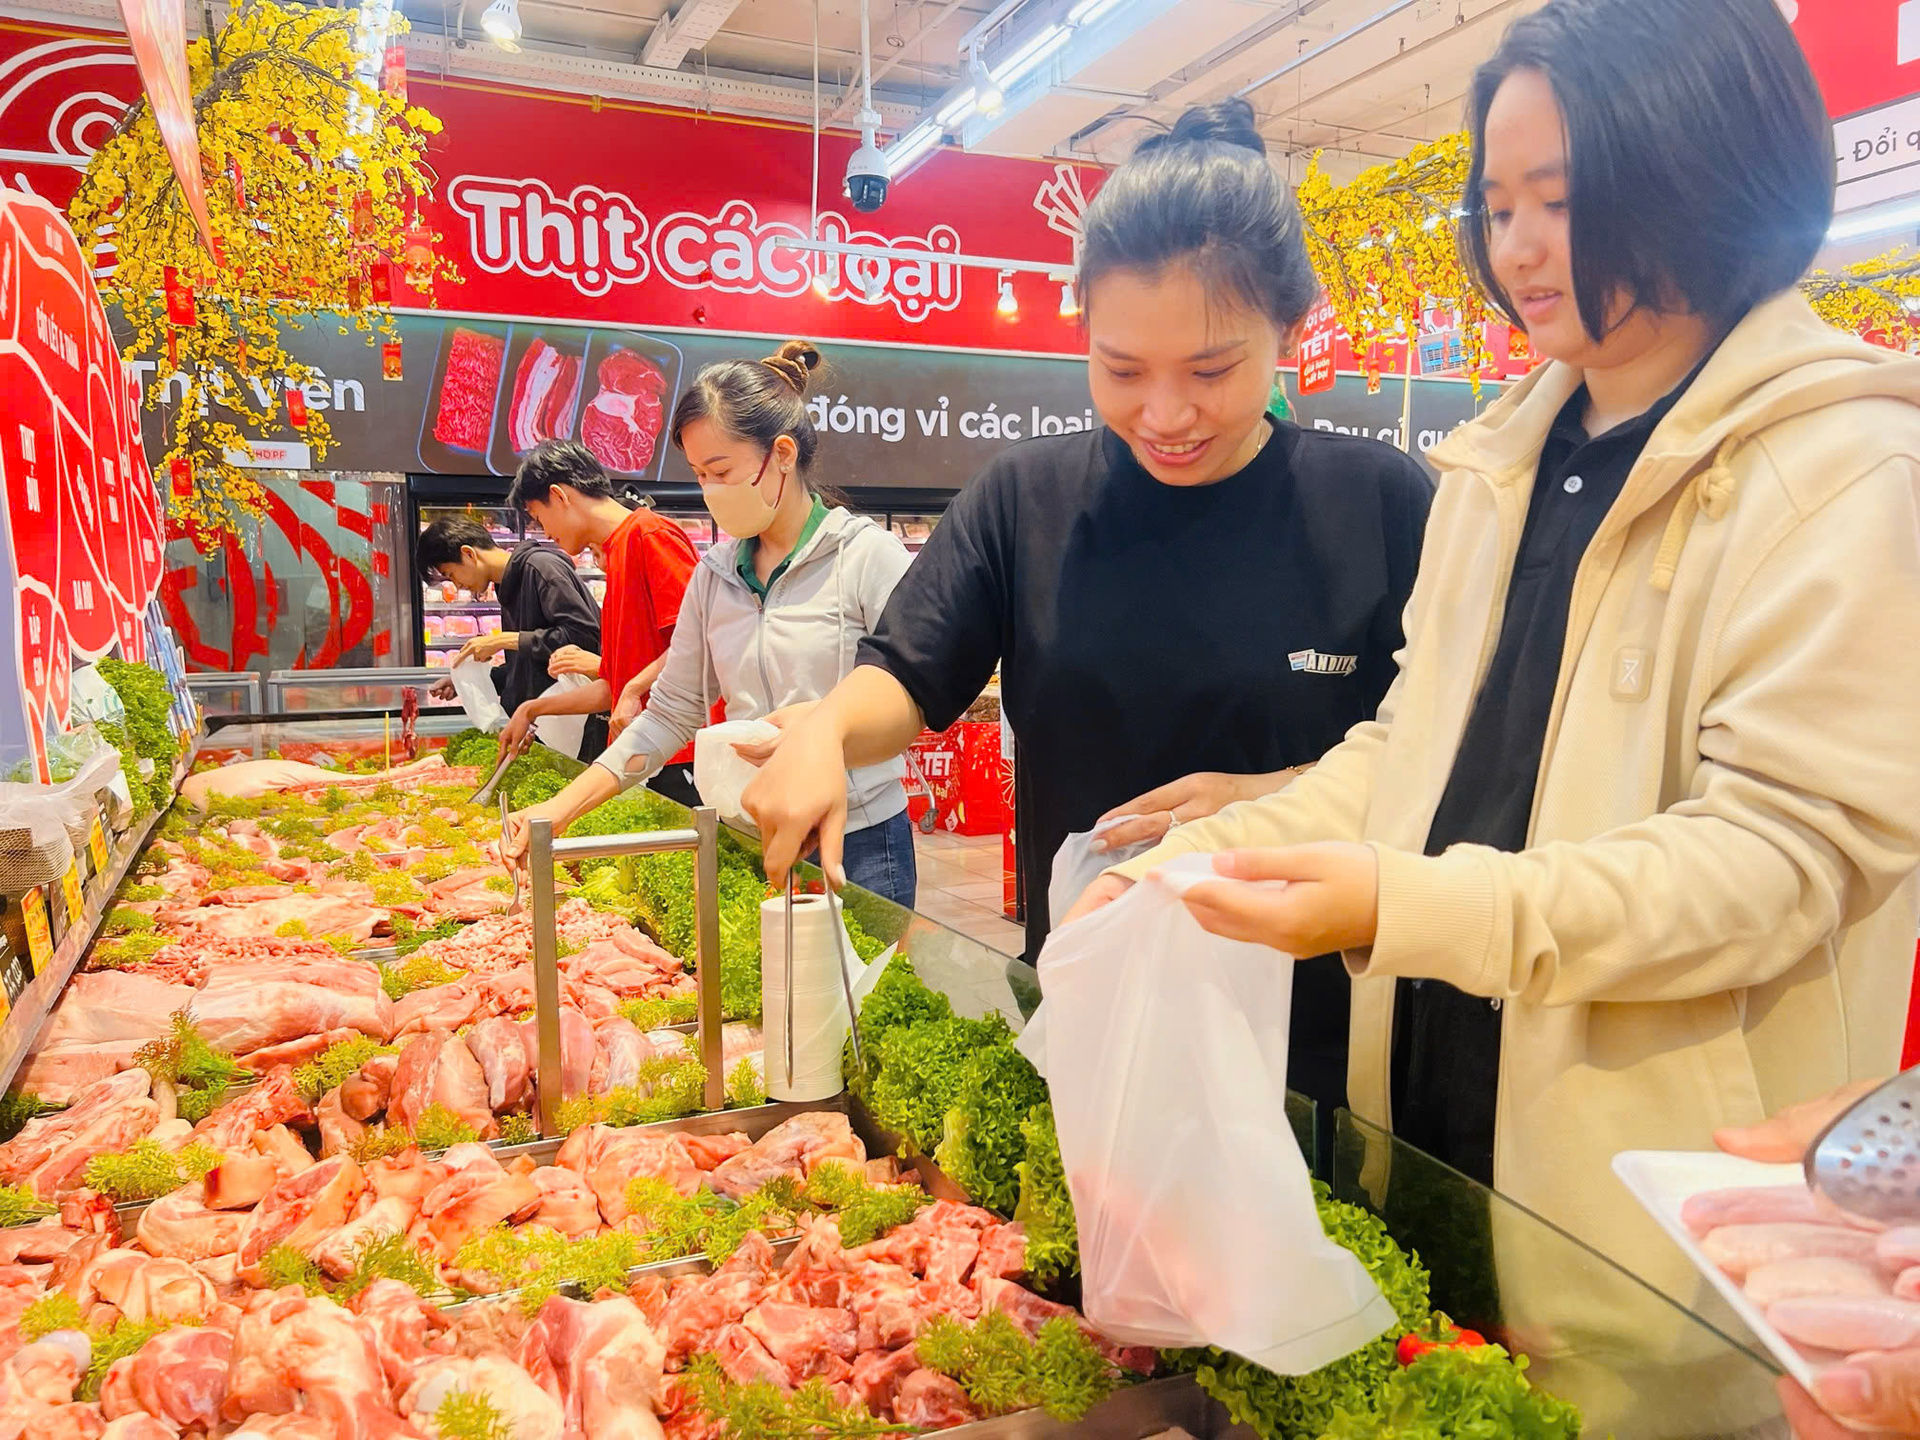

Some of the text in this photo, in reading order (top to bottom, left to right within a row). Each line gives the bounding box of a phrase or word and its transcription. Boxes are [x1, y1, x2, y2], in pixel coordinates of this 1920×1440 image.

[1853, 127, 1897, 162] Đổi
[460, 186, 642, 286] Thịt
[663, 211, 806, 288] các
[1301, 325, 1333, 361] TẾT
[805, 395, 905, 442] đóng
[915, 396, 950, 437] vỉ
[958, 402, 1021, 440] các
[923, 741, 954, 776] TẾT
